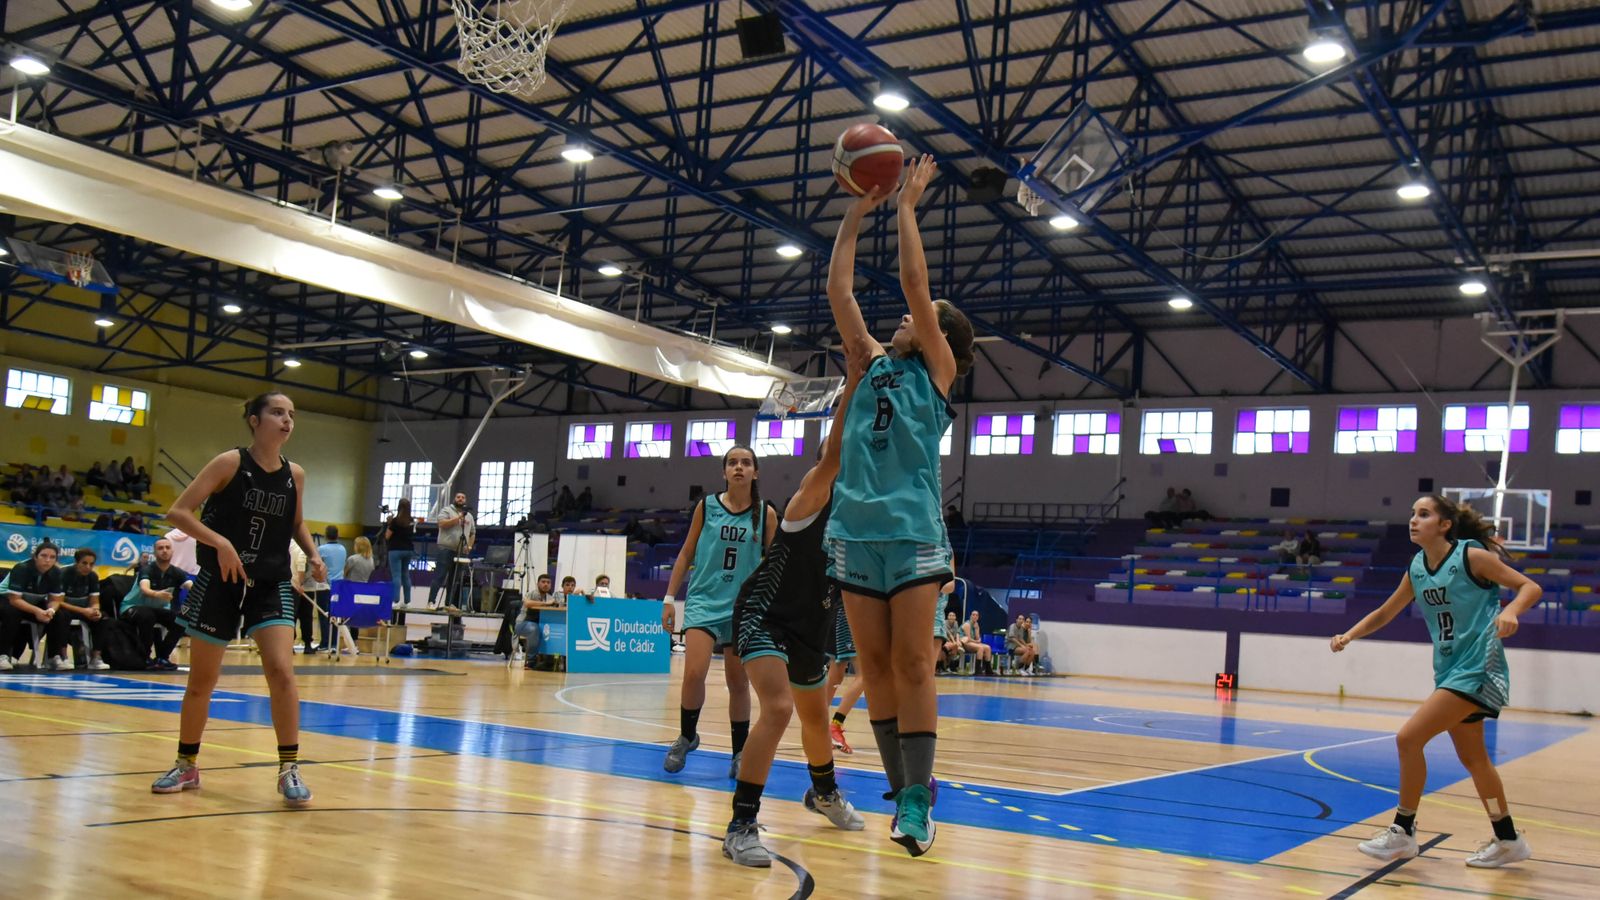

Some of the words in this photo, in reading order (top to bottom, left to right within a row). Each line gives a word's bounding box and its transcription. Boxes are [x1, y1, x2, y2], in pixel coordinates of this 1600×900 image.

[242, 488, 287, 516] ALM
[249, 516, 266, 550] 7
[720, 525, 748, 543] CDZ
[723, 546, 738, 571] 6
[1423, 586, 1451, 606] CDZ
[614, 618, 664, 635] Diputación
[1437, 611, 1455, 641] 12
[614, 639, 626, 652] de
[629, 638, 655, 653] Cádiz
[1216, 673, 1233, 688] 24
